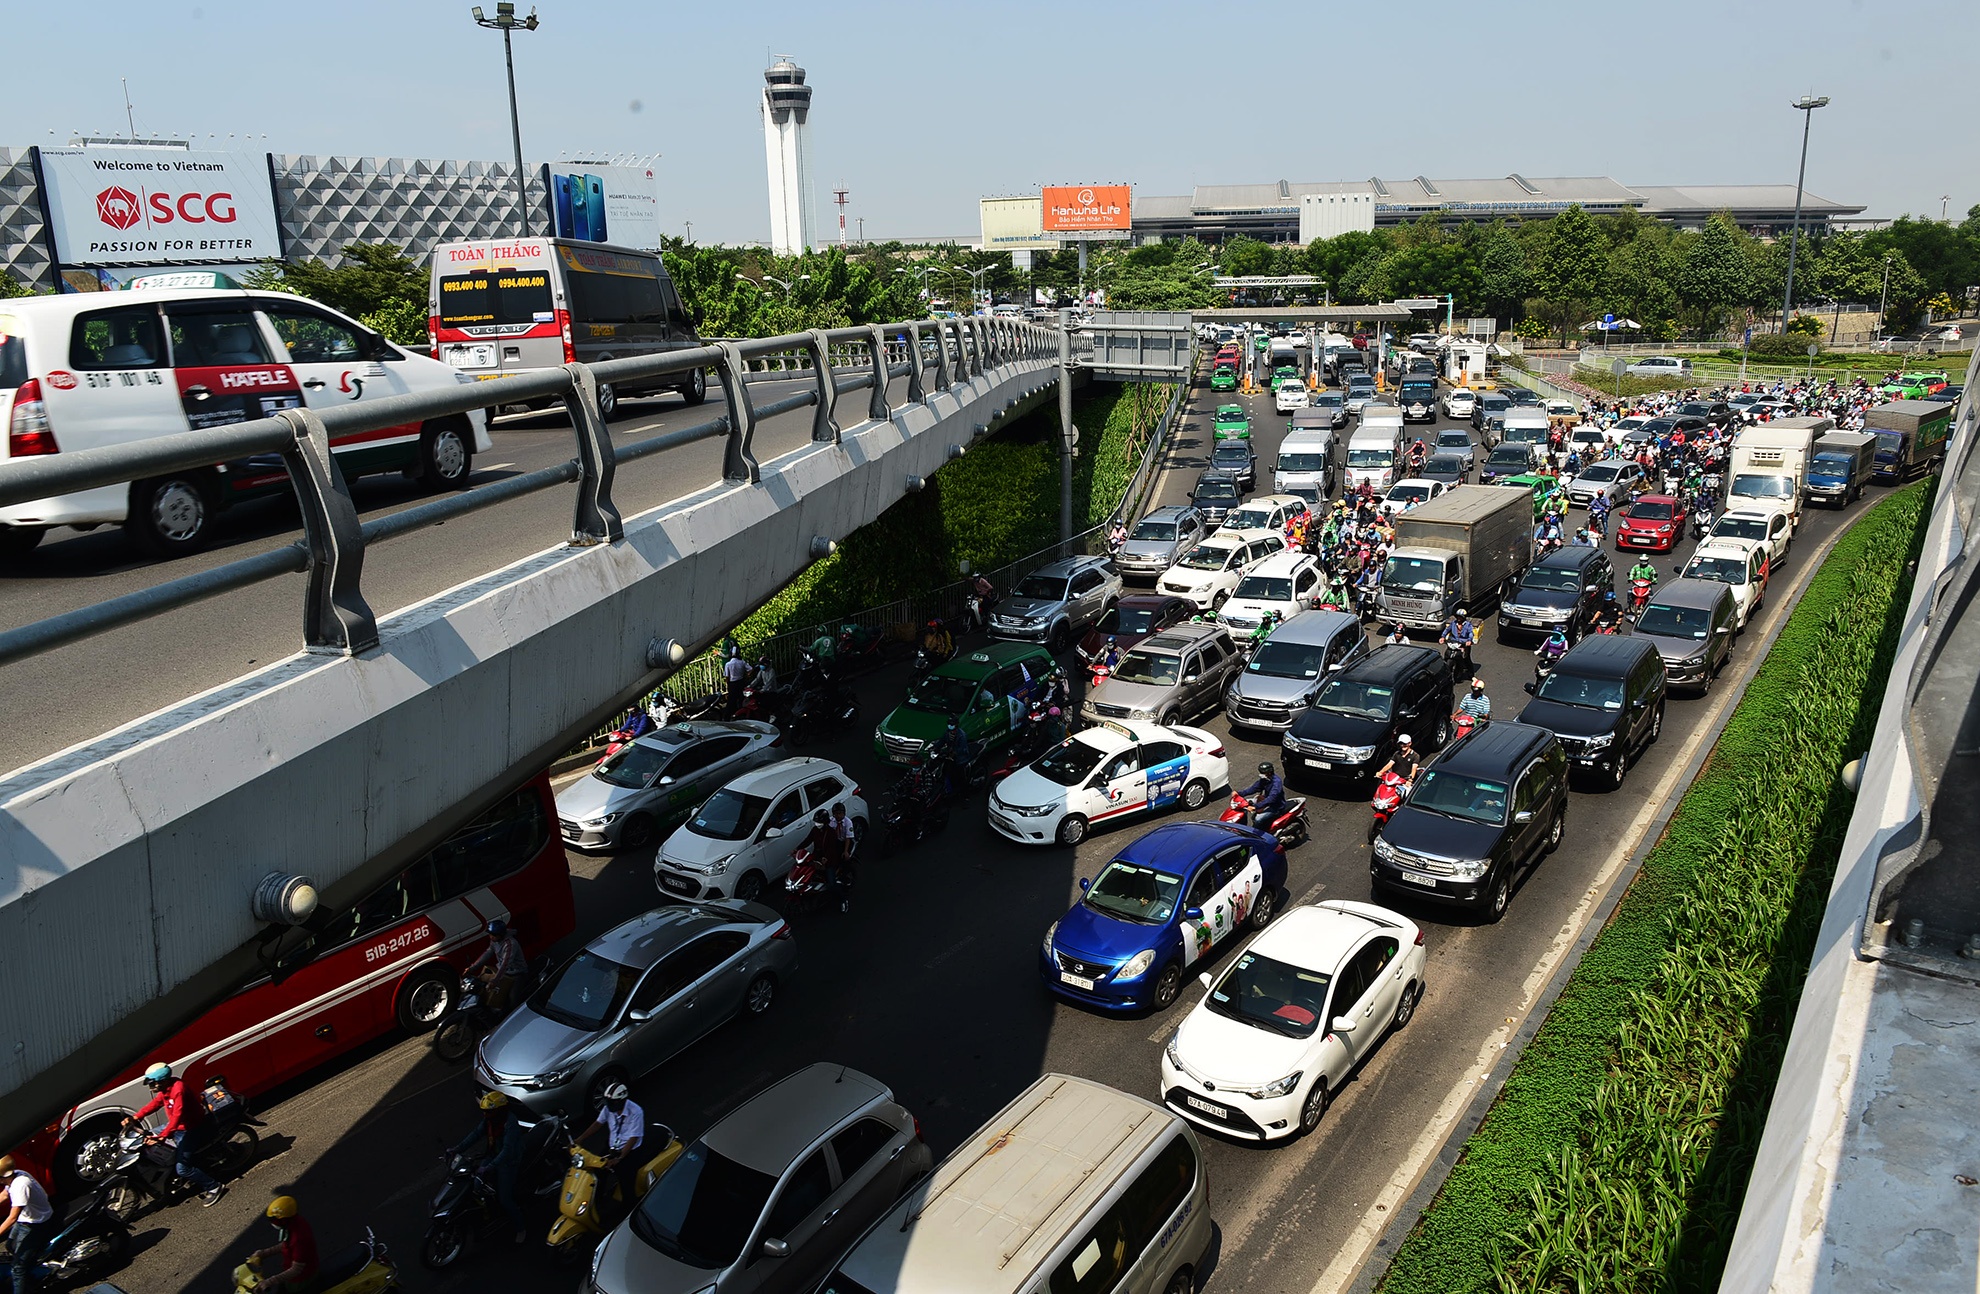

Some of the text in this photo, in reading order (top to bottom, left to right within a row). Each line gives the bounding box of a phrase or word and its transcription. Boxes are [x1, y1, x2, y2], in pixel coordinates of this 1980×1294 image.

[93, 160, 224, 172] Welcome to Vietnam
[149, 192, 236, 223] SCG
[1051, 206, 1121, 216] Hanwha Life
[90, 239, 252, 252] PASSION FOR BETTER
[449, 240, 541, 262] TOÀN THẮNG
[1390, 599, 1406, 607] MINH
[1105, 799, 1129, 810] VINASUN
[365, 924, 430, 962] 51B-247.26
